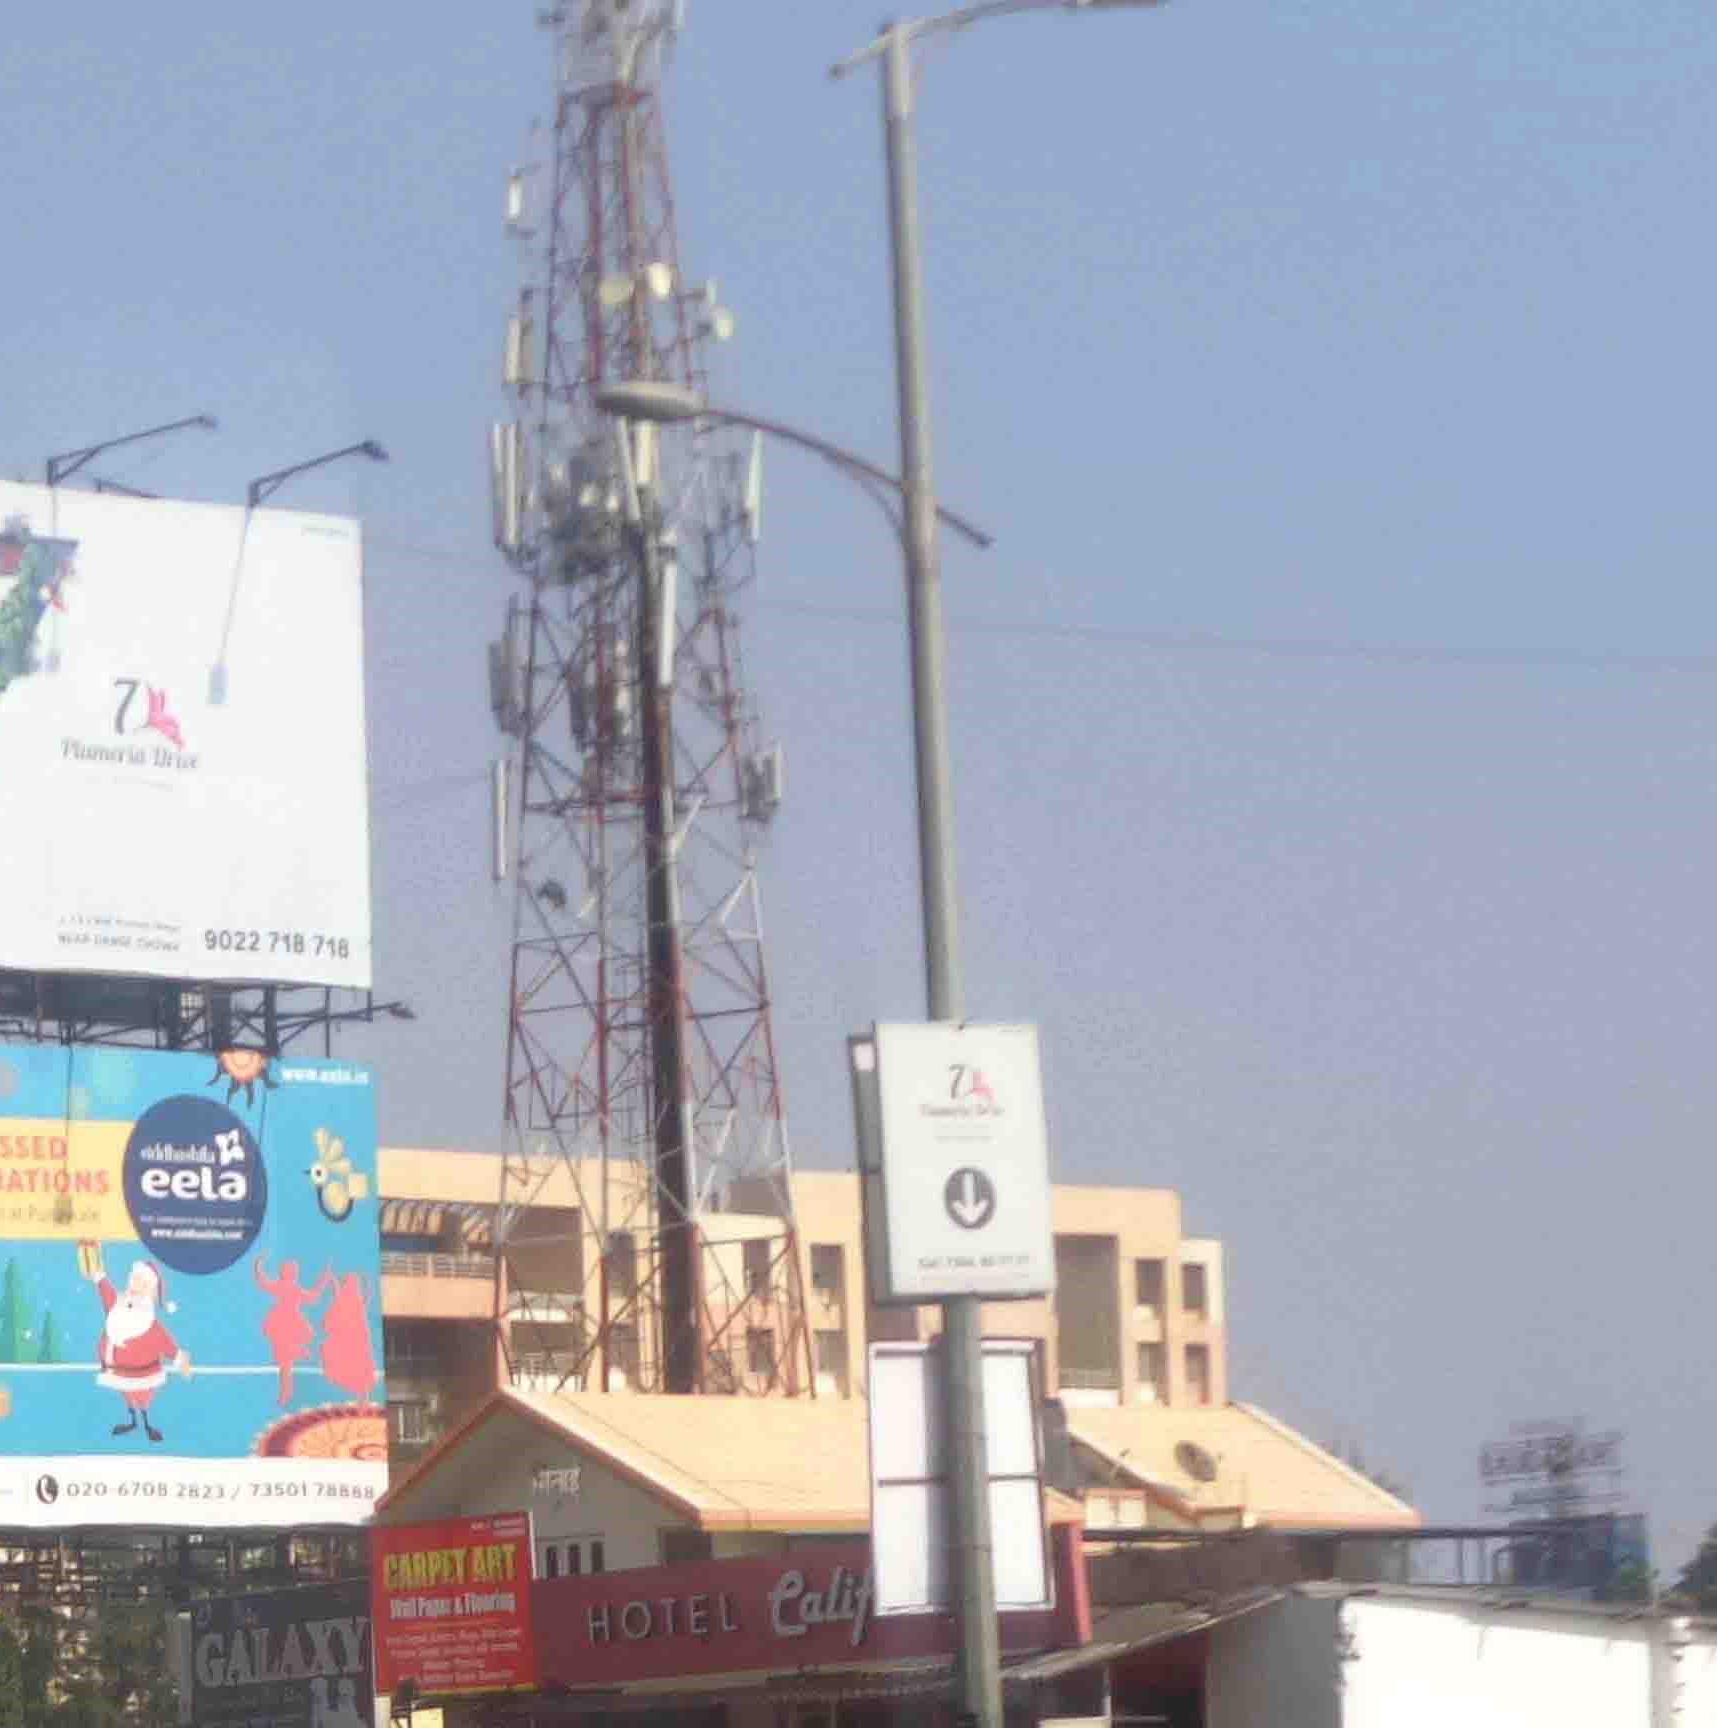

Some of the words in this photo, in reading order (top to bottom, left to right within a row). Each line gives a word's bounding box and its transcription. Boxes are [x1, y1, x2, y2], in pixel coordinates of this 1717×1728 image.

[113, 677, 141, 735] 7
[205, 928, 262, 952] 9022
[268, 930, 306, 955] 718
[314, 934, 349, 960] 718
[141, 1165, 248, 1201] eela
[67, 1481, 108, 1498] 020
[384, 1549, 466, 1591] CARPET
[468, 1544, 517, 1584] ART
[586, 1593, 739, 1644] HOTEL
[770, 1566, 876, 1647] Calif
[195, 1617, 370, 1688] GALAXY
